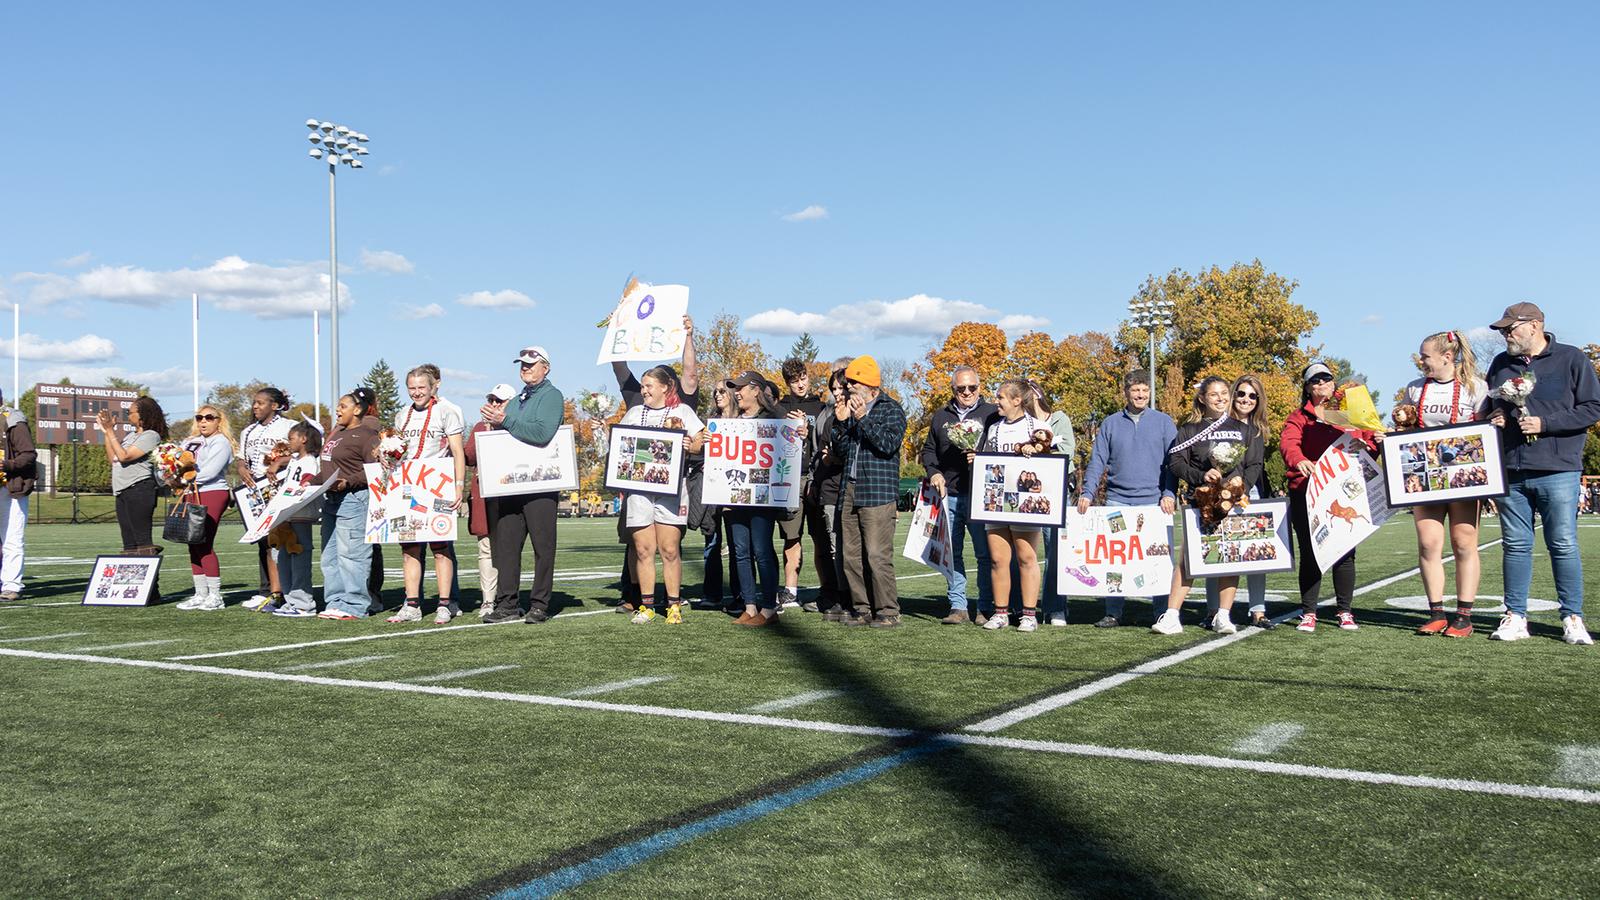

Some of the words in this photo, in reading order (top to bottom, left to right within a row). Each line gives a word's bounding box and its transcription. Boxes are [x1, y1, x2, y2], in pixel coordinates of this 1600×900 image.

[40, 386, 82, 395] BERYLSON
[84, 388, 111, 397] FAMILY
[113, 390, 137, 398] FIELDS
[38, 397, 59, 405] HOME
[1421, 404, 1465, 416] ROWN
[38, 420, 61, 429] DOWN
[65, 421, 75, 429] TO
[75, 422, 87, 430] GO
[709, 433, 774, 468] BUBS
[369, 461, 454, 503] NIKKI
[1085, 534, 1144, 565] LARA
